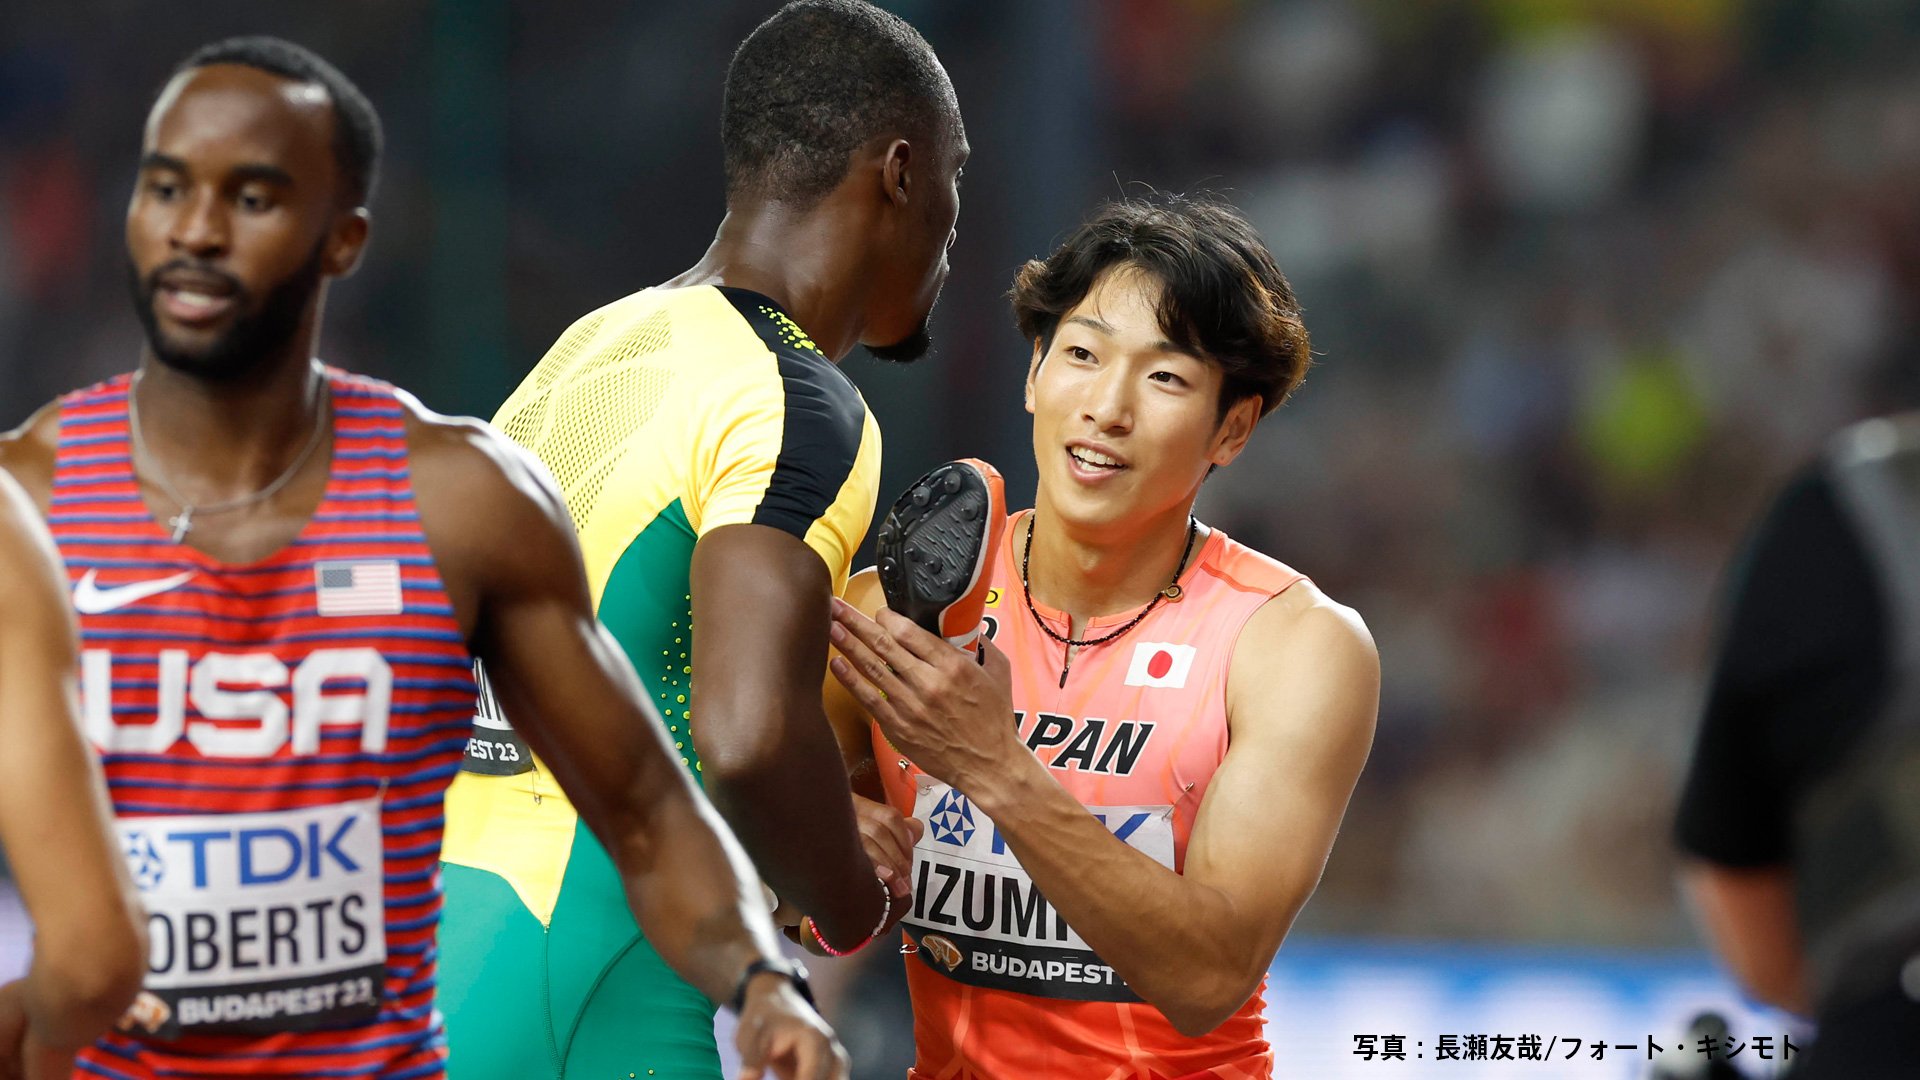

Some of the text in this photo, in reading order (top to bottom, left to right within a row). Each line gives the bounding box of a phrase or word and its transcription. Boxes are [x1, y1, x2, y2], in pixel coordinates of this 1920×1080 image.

[80, 648, 393, 757] USA
[495, 742, 520, 762] 23
[167, 815, 361, 888] TDK
[149, 894, 366, 974] OBERTS
[972, 951, 1115, 985] BUDAPEST
[177, 982, 337, 1025] BUDAPEST
